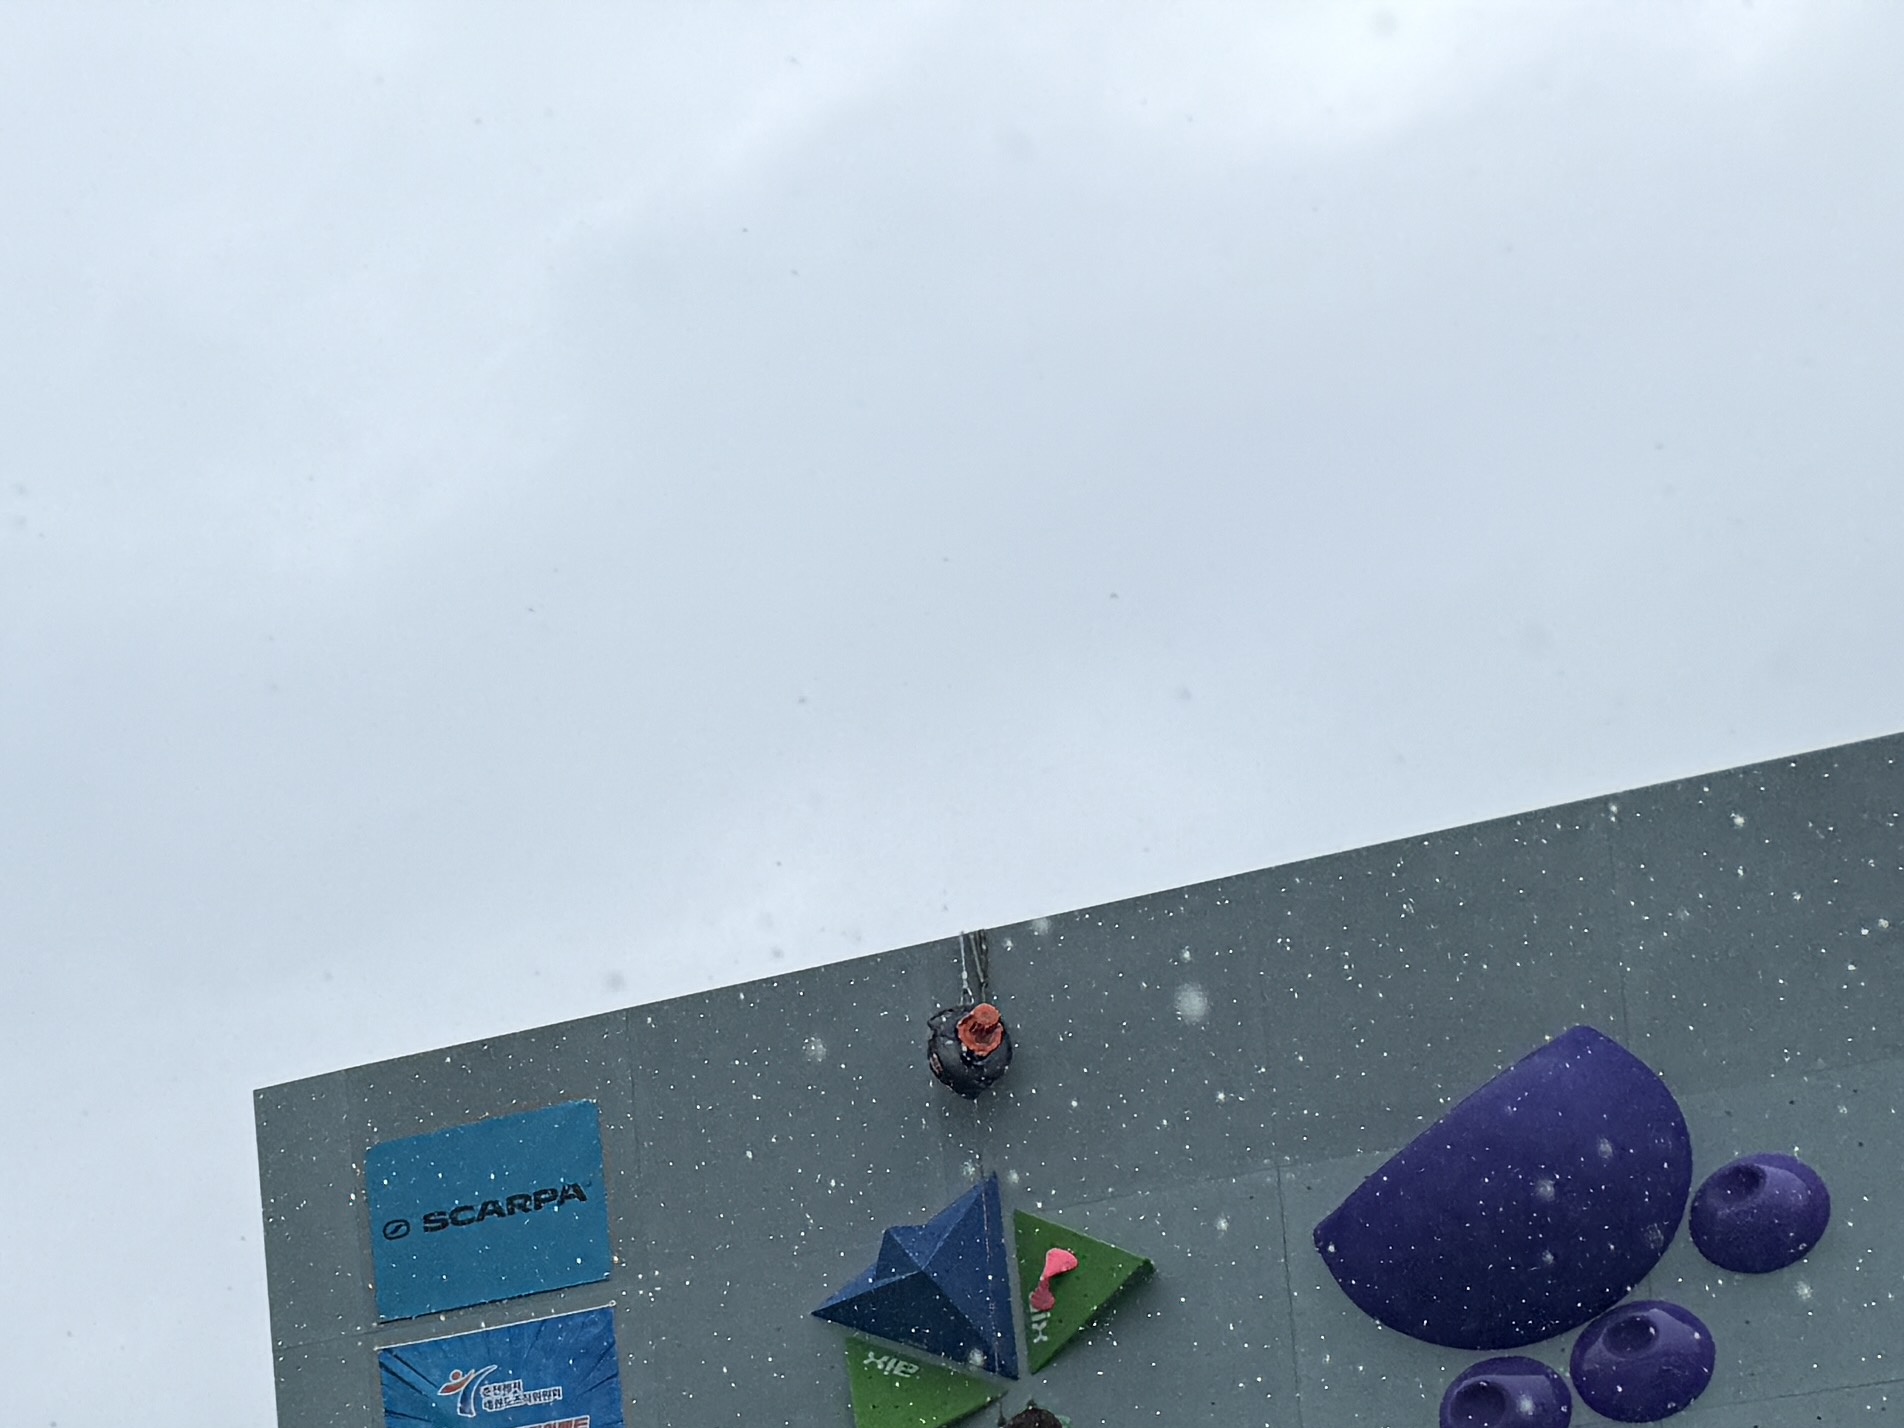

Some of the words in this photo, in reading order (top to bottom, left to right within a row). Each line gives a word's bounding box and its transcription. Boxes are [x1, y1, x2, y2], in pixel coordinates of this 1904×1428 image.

[422, 1183, 587, 1233] SCARPA
[1029, 1291, 1051, 1343] ix
[863, 1351, 920, 1378] aix
